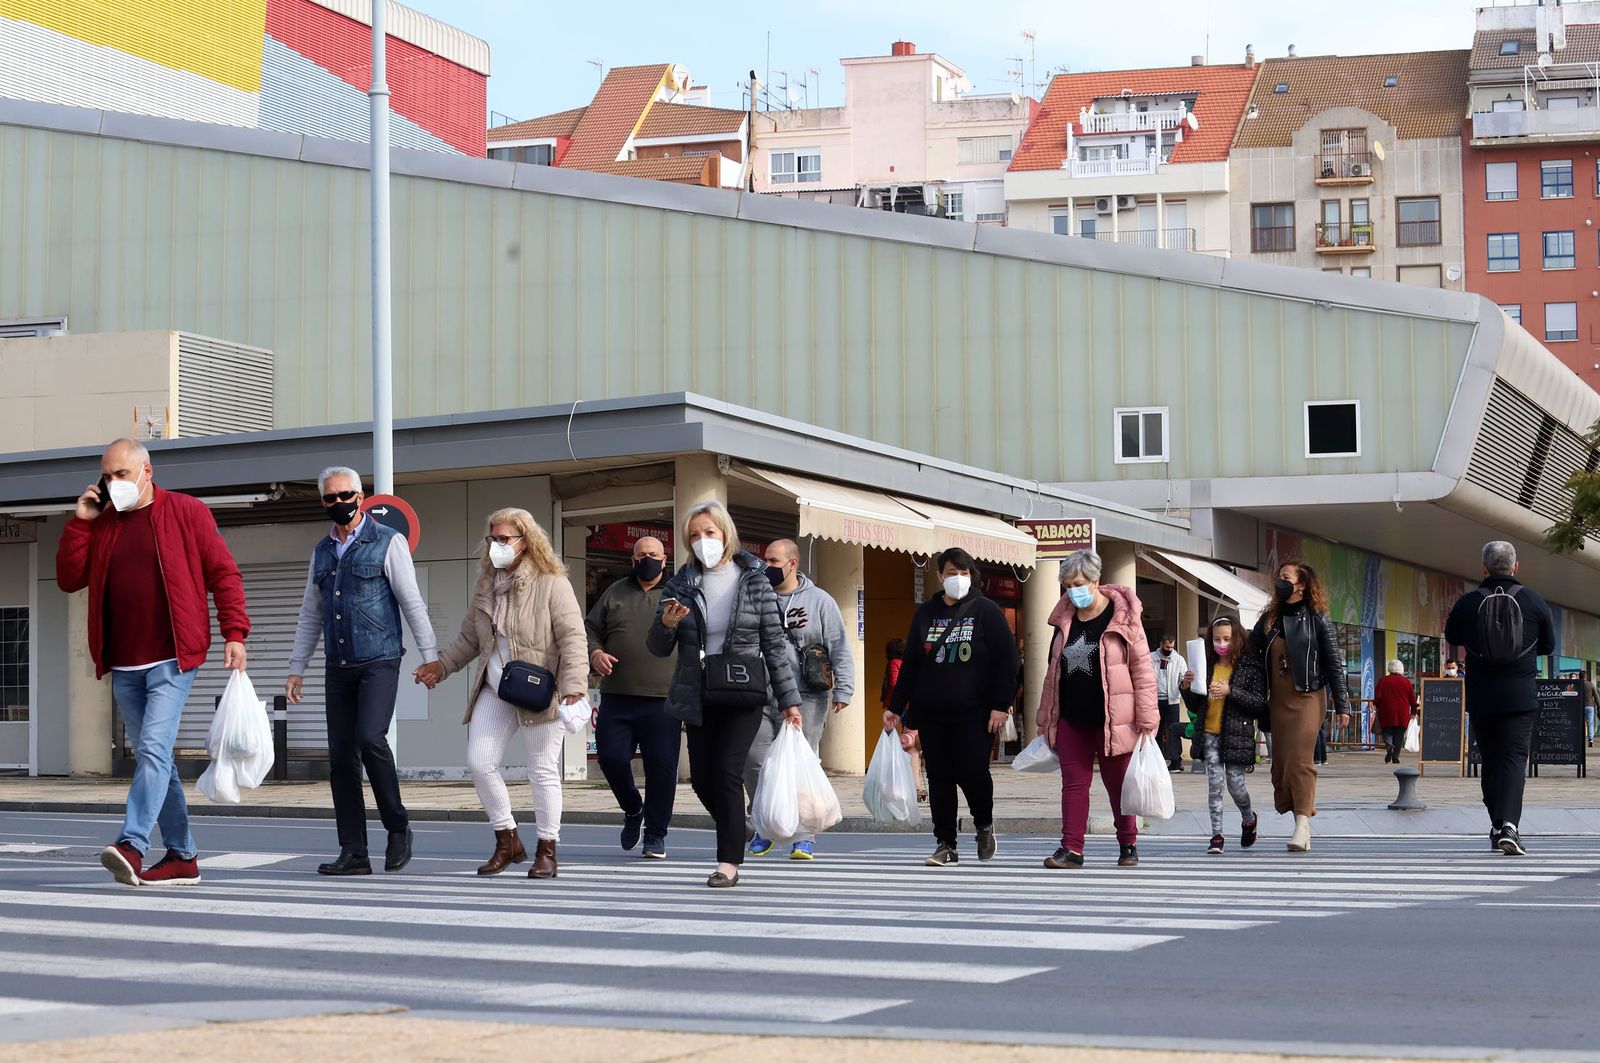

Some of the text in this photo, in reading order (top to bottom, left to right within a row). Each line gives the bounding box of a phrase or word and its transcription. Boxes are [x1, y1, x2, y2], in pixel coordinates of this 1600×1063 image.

[627, 526, 669, 542] FRUTOS SECOS
[843, 518, 896, 545] FRUTOS SECOS
[1035, 523, 1091, 539] TABACOS
[933, 617, 974, 627] VINGE
[945, 635, 973, 644] EDITION
